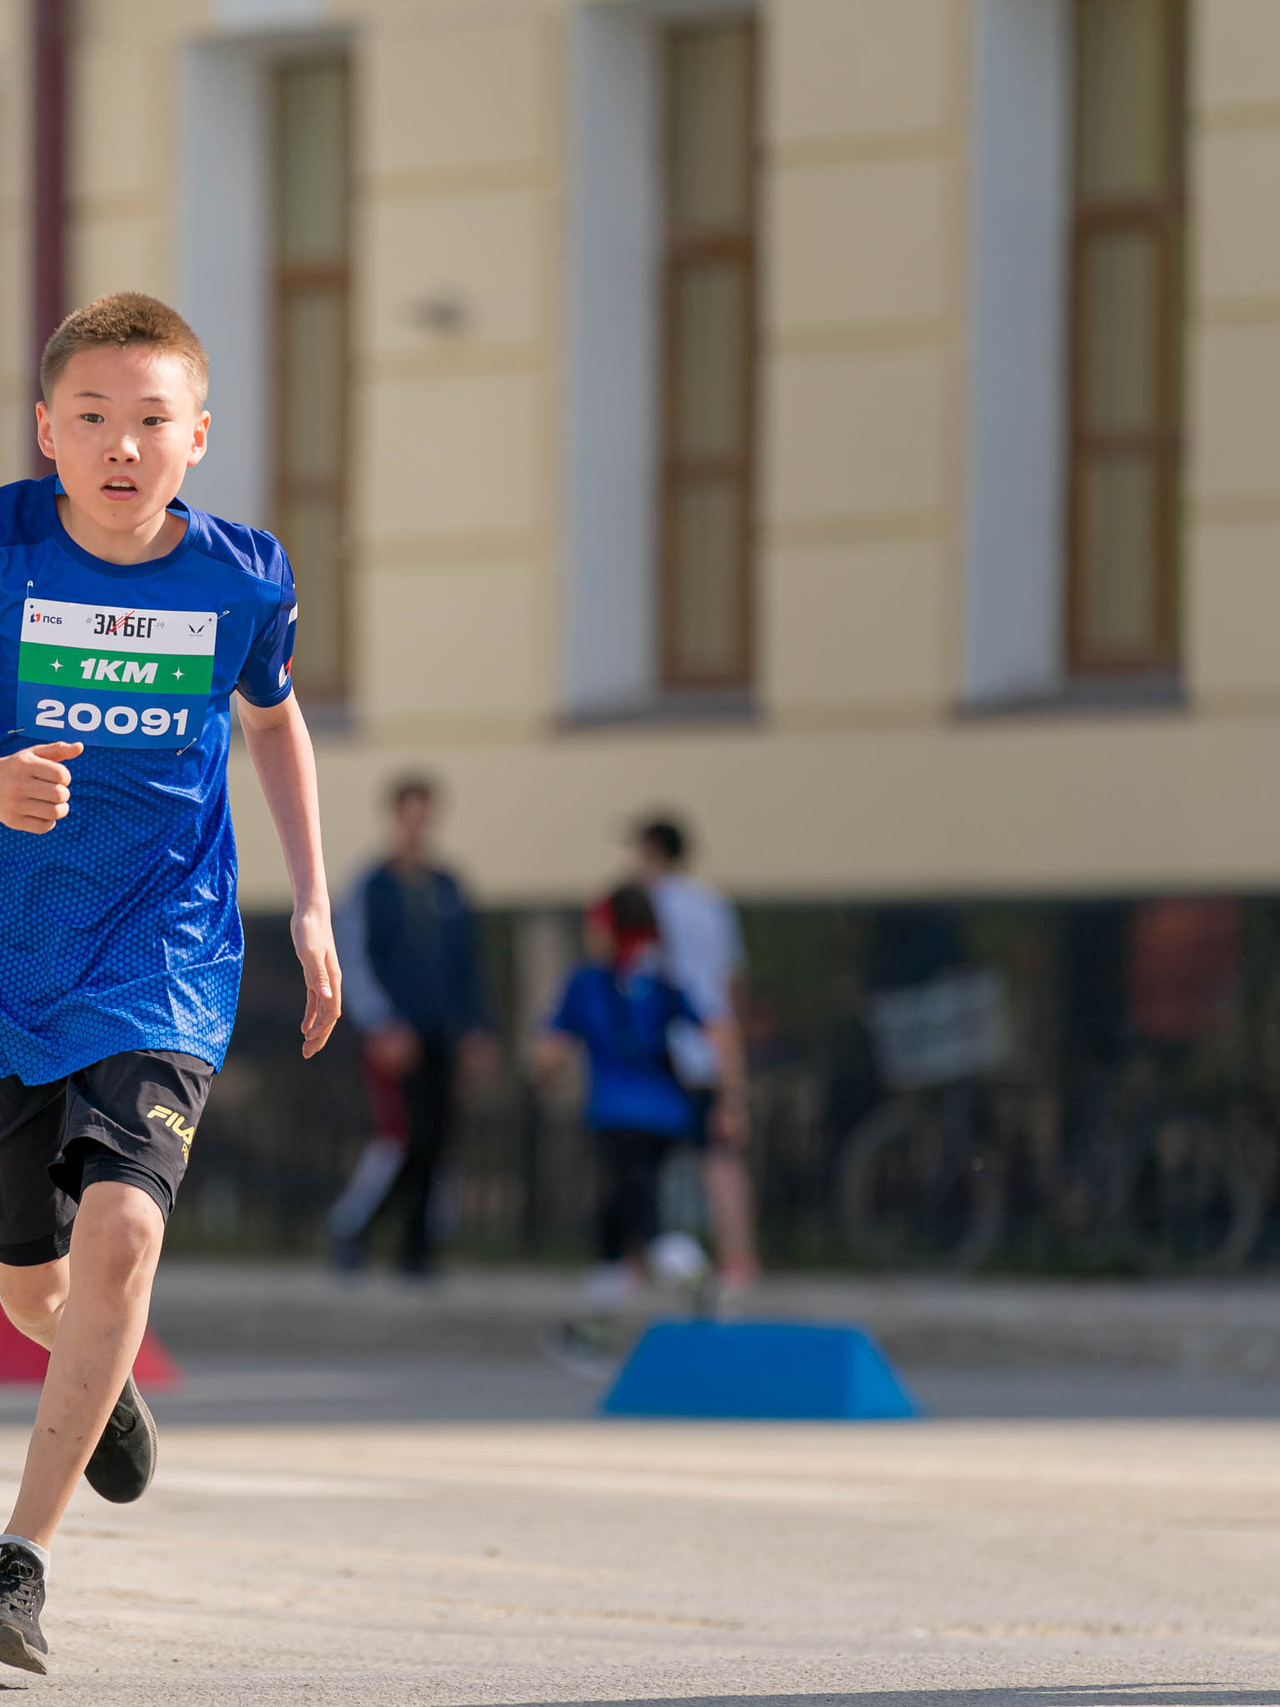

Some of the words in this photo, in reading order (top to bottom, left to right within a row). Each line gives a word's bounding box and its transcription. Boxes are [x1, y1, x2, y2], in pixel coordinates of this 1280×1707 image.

[42, 615, 63, 625] ПСБ
[80, 658, 159, 684] 1КМ
[35, 699, 189, 736] 20091
[147, 1105, 195, 1145] FILA
